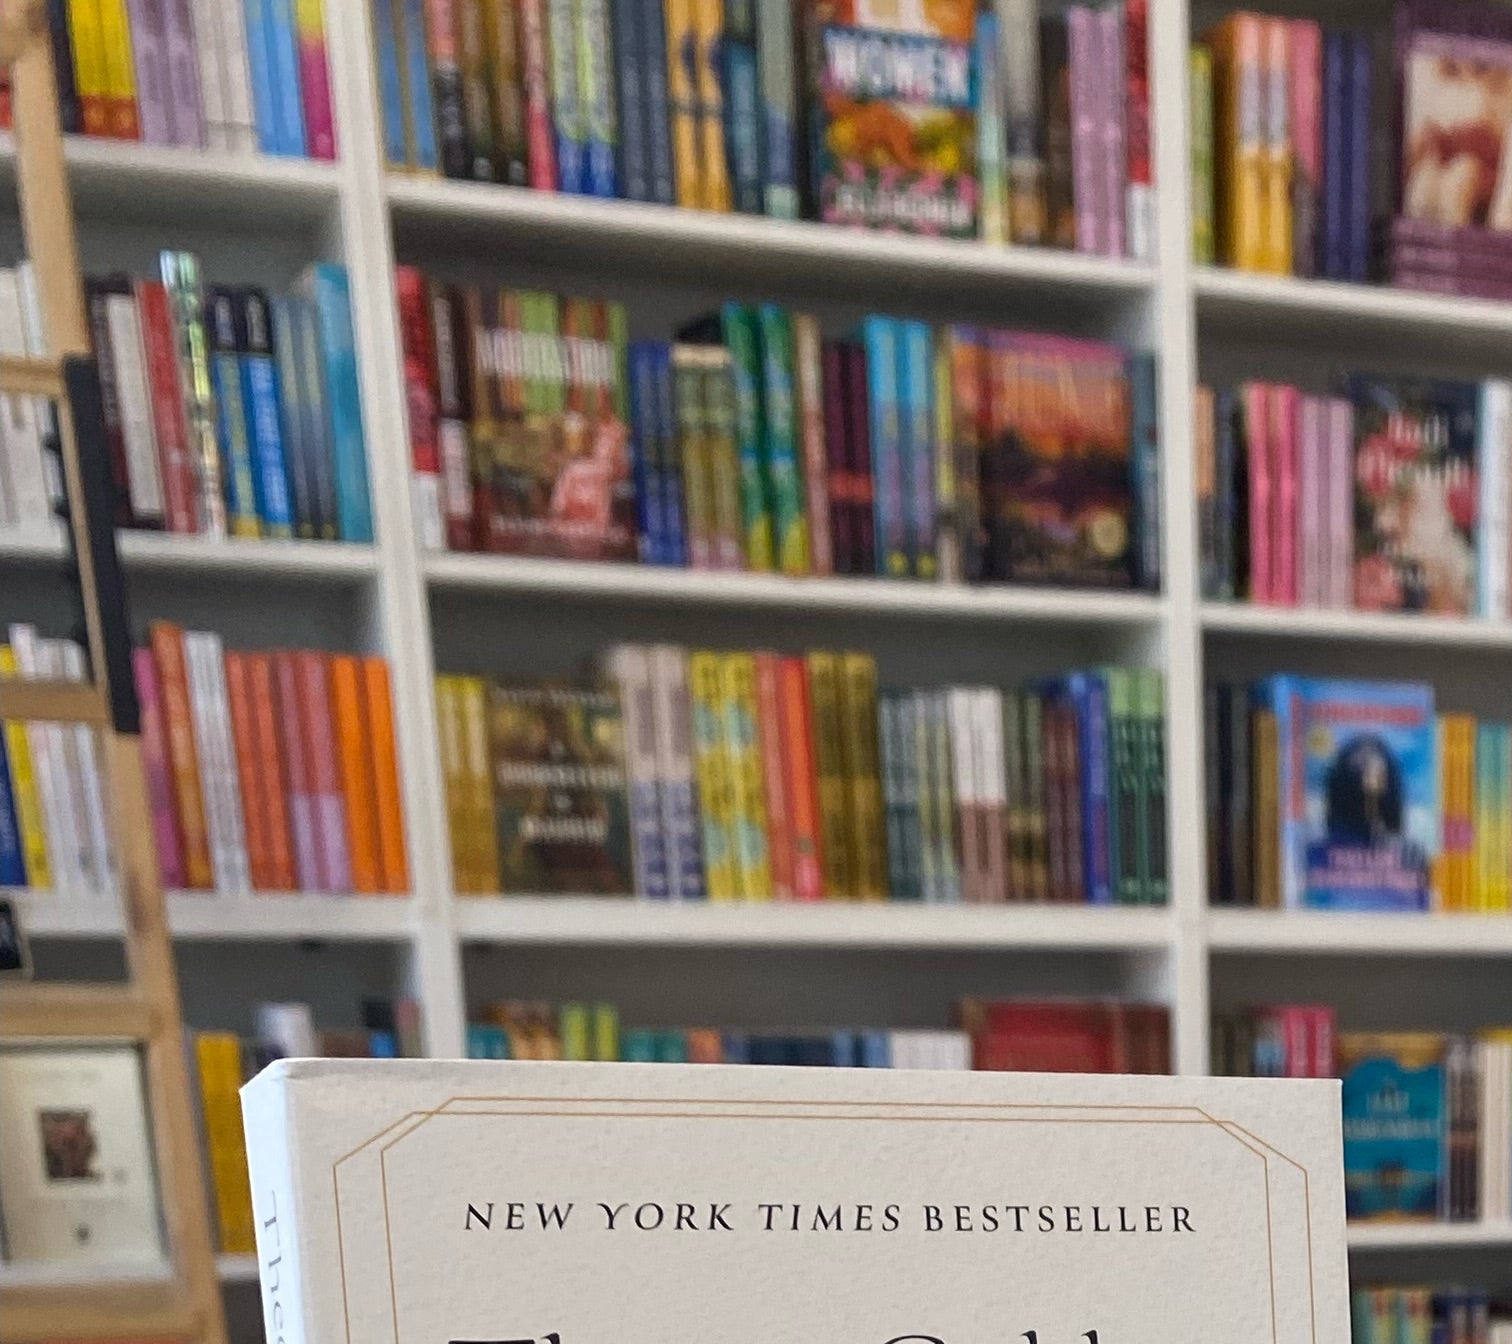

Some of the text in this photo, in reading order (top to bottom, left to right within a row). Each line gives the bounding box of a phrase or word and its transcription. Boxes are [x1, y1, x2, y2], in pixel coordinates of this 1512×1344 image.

[464, 1202, 1197, 1232] NEW YORK TIMES BESTSELLER
